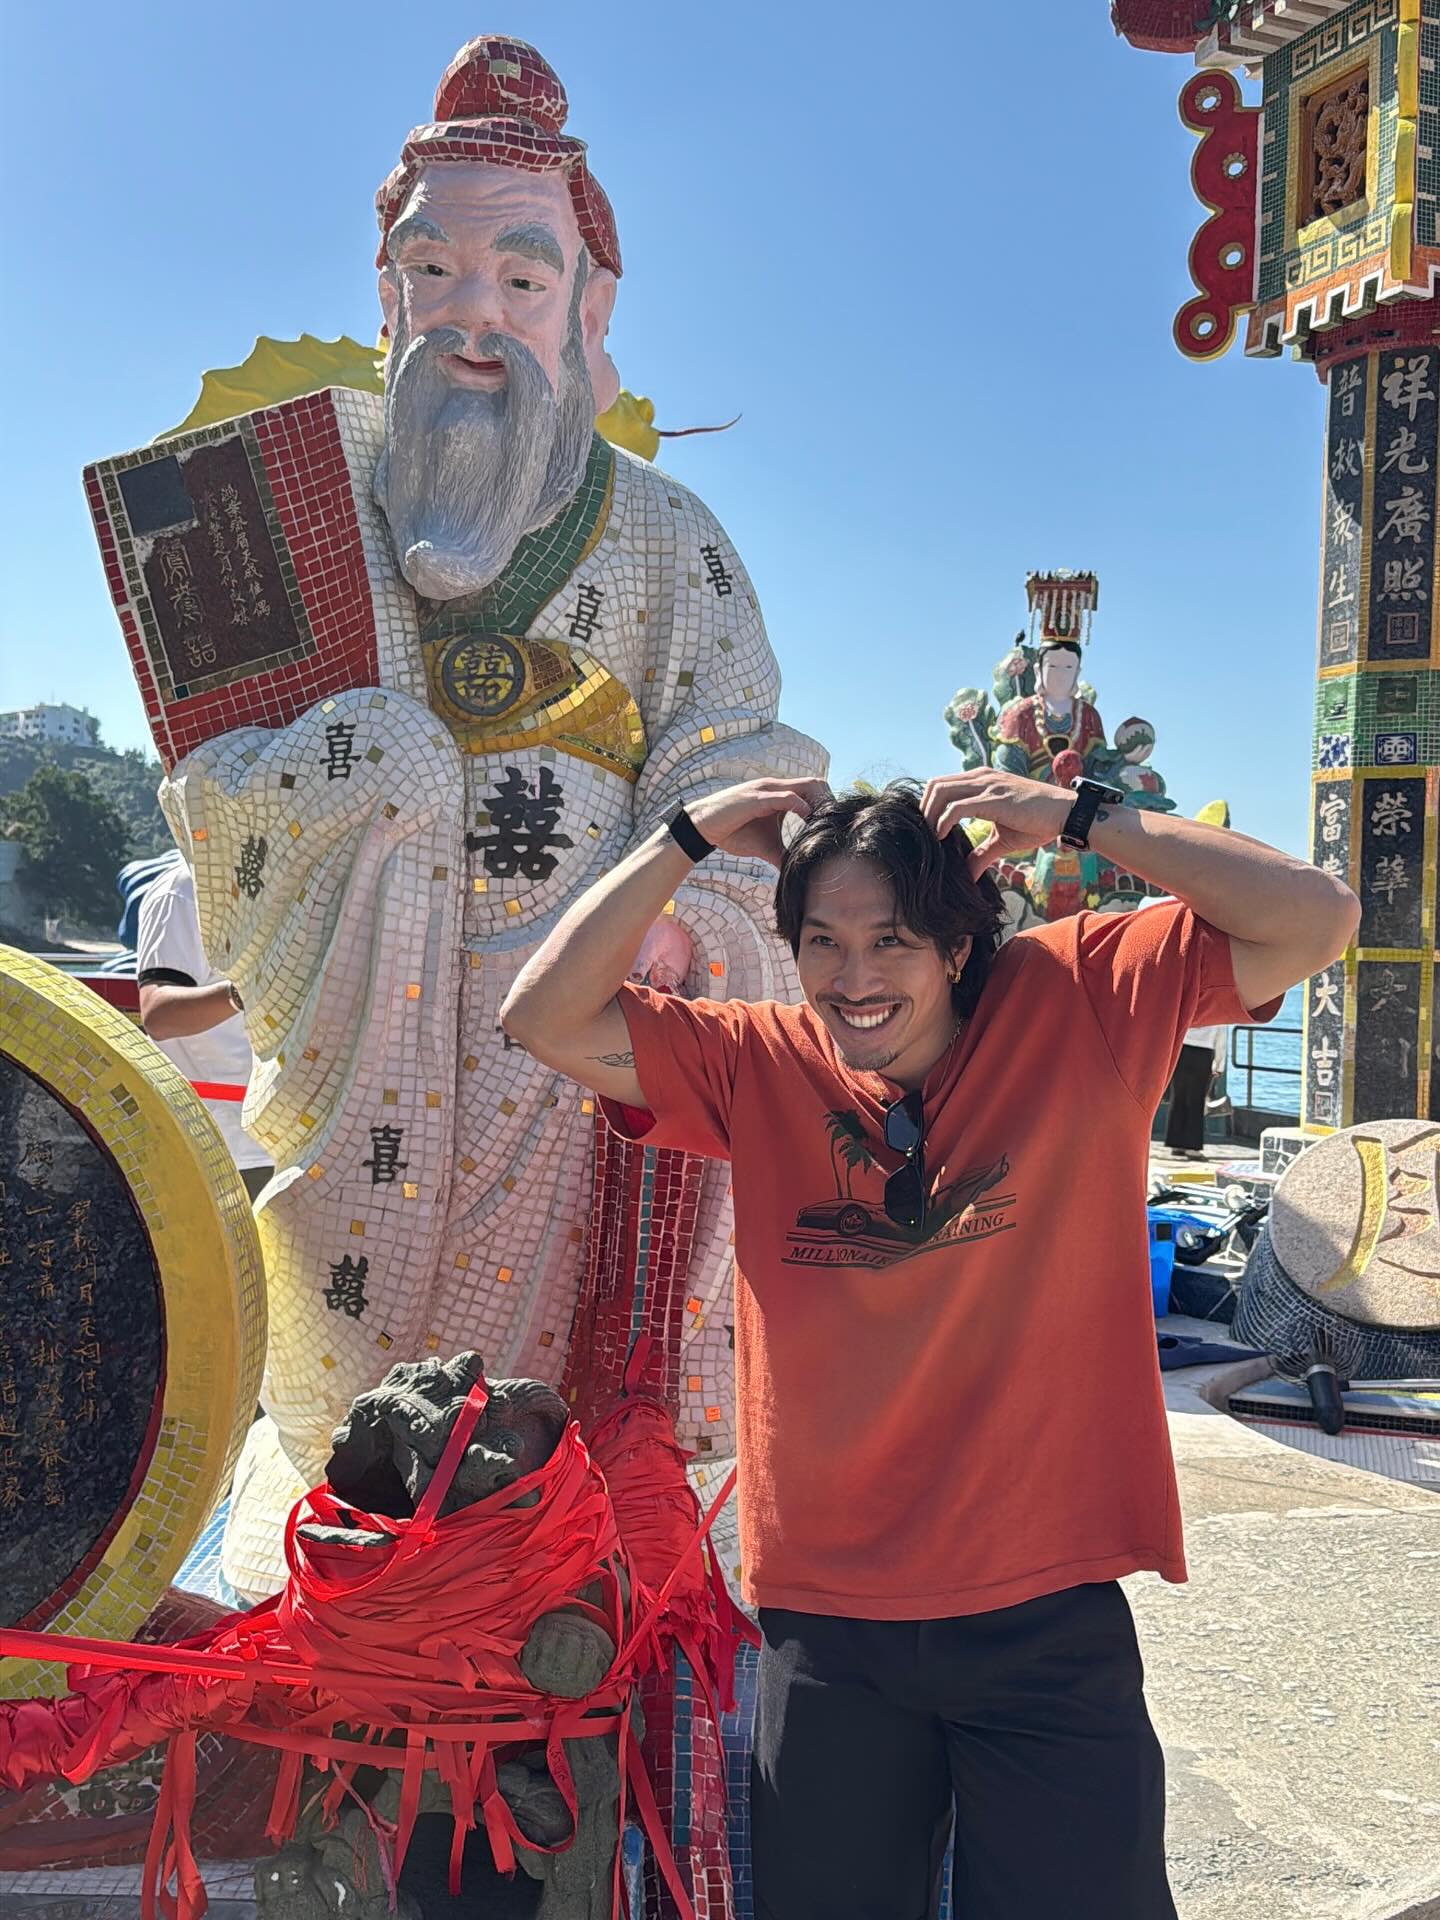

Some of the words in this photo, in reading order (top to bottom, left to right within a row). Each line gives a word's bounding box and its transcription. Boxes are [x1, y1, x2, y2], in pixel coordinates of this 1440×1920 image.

[1376, 354, 1435, 602] 祥光廣照
[700, 544, 732, 597] 喜
[565, 583, 605, 642] 喜
[320, 721, 361, 780] 喜
[466, 766, 574, 880] 囍
[1370, 791, 1414, 904] 榮華
[1311, 972, 1342, 1086] 大吉
[362, 1125, 408, 1184] 喜
[322, 1254, 369, 1320] 囍
[790, 1247, 890, 1265] MILLIONAIR
